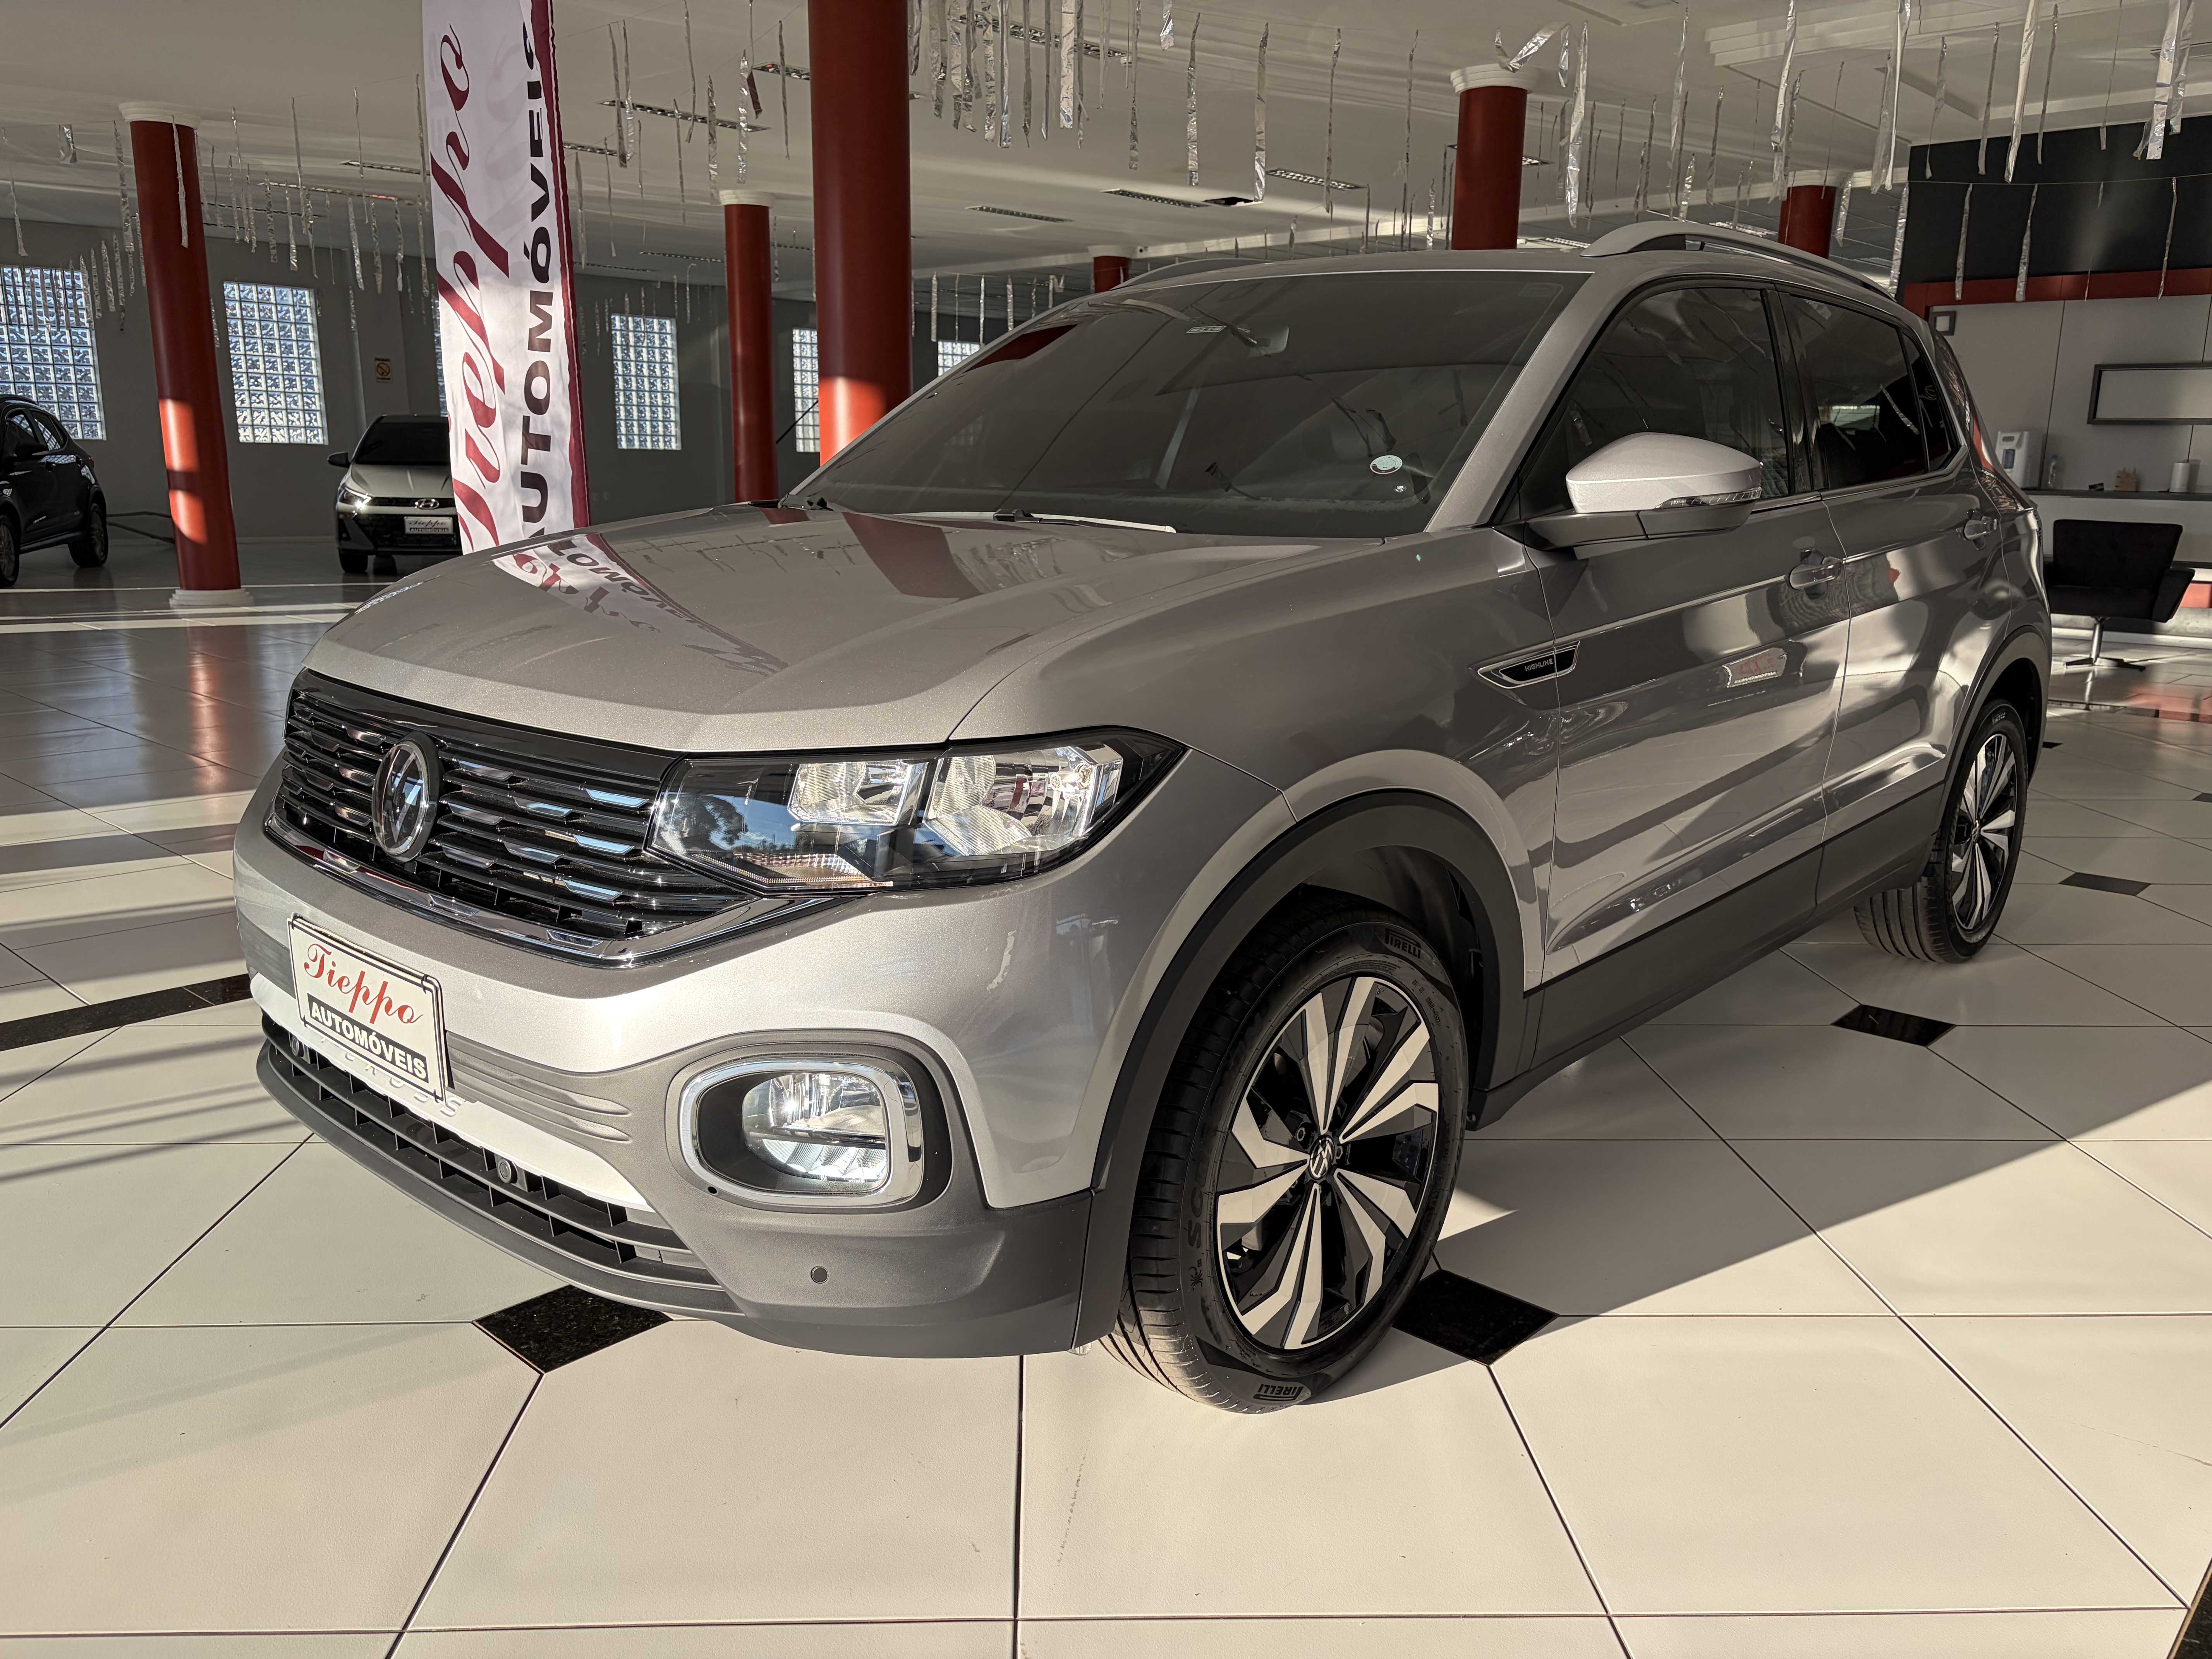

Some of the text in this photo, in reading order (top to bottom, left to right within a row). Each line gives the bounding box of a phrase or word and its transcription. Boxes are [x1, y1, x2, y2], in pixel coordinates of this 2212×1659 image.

[1525, 658, 1554, 672] HIGHLINE
[1384, 928, 1422, 959] PIRELLI
[304, 943, 424, 1024] Tieppo
[311, 1001, 426, 1079] AUTOMÓVEIS
[1253, 1384, 1304, 1401] PIRELLI
